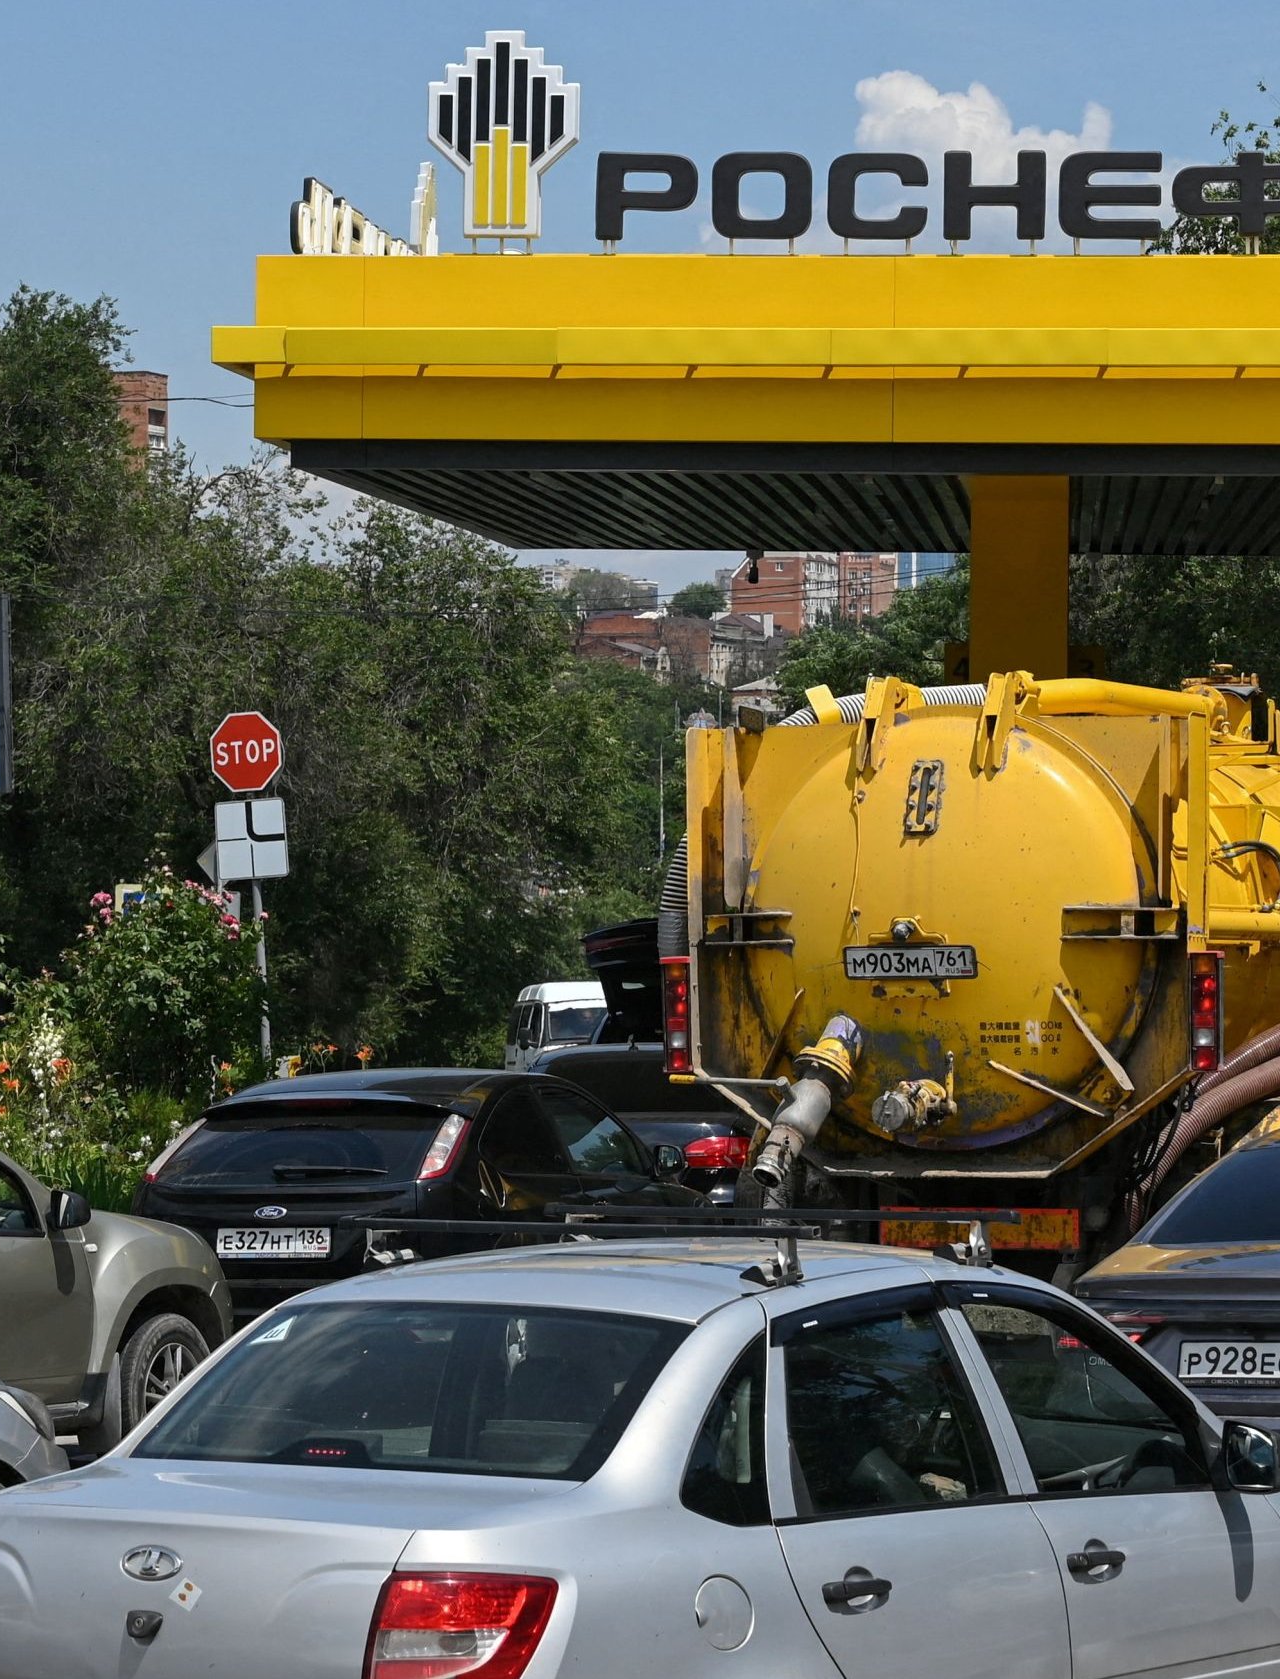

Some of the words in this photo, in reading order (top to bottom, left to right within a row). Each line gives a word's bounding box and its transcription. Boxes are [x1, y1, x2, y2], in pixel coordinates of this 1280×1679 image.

[216, 738, 275, 766] STOP
[852, 952, 933, 973] М903МА
[935, 950, 967, 967] 761
[223, 1231, 293, 1250] Е327НТ
[298, 1229, 325, 1245] 136
